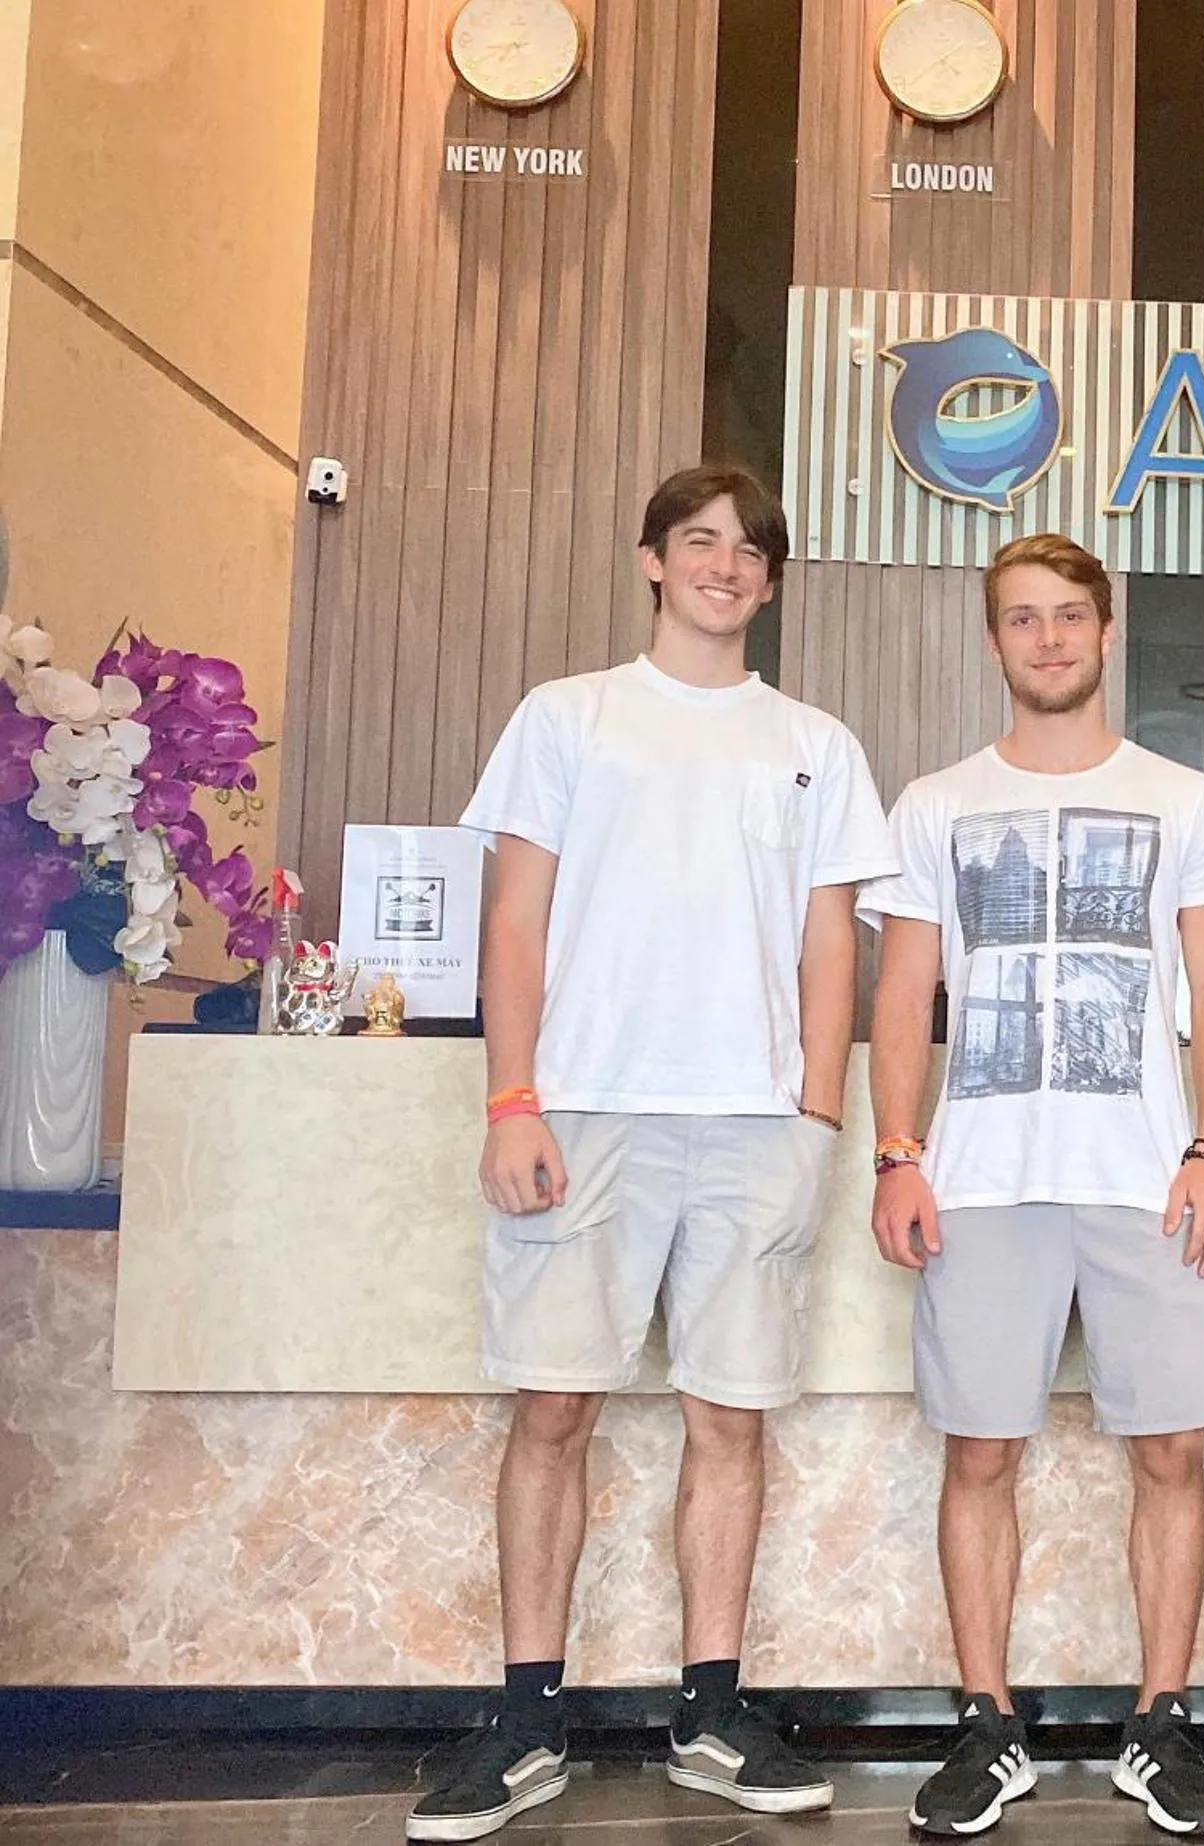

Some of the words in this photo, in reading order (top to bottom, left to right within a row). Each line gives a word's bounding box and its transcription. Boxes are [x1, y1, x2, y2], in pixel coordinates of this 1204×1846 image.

[446, 145, 506, 173] NEW
[513, 147, 583, 176] YORK
[891, 162, 993, 192] LONDON
